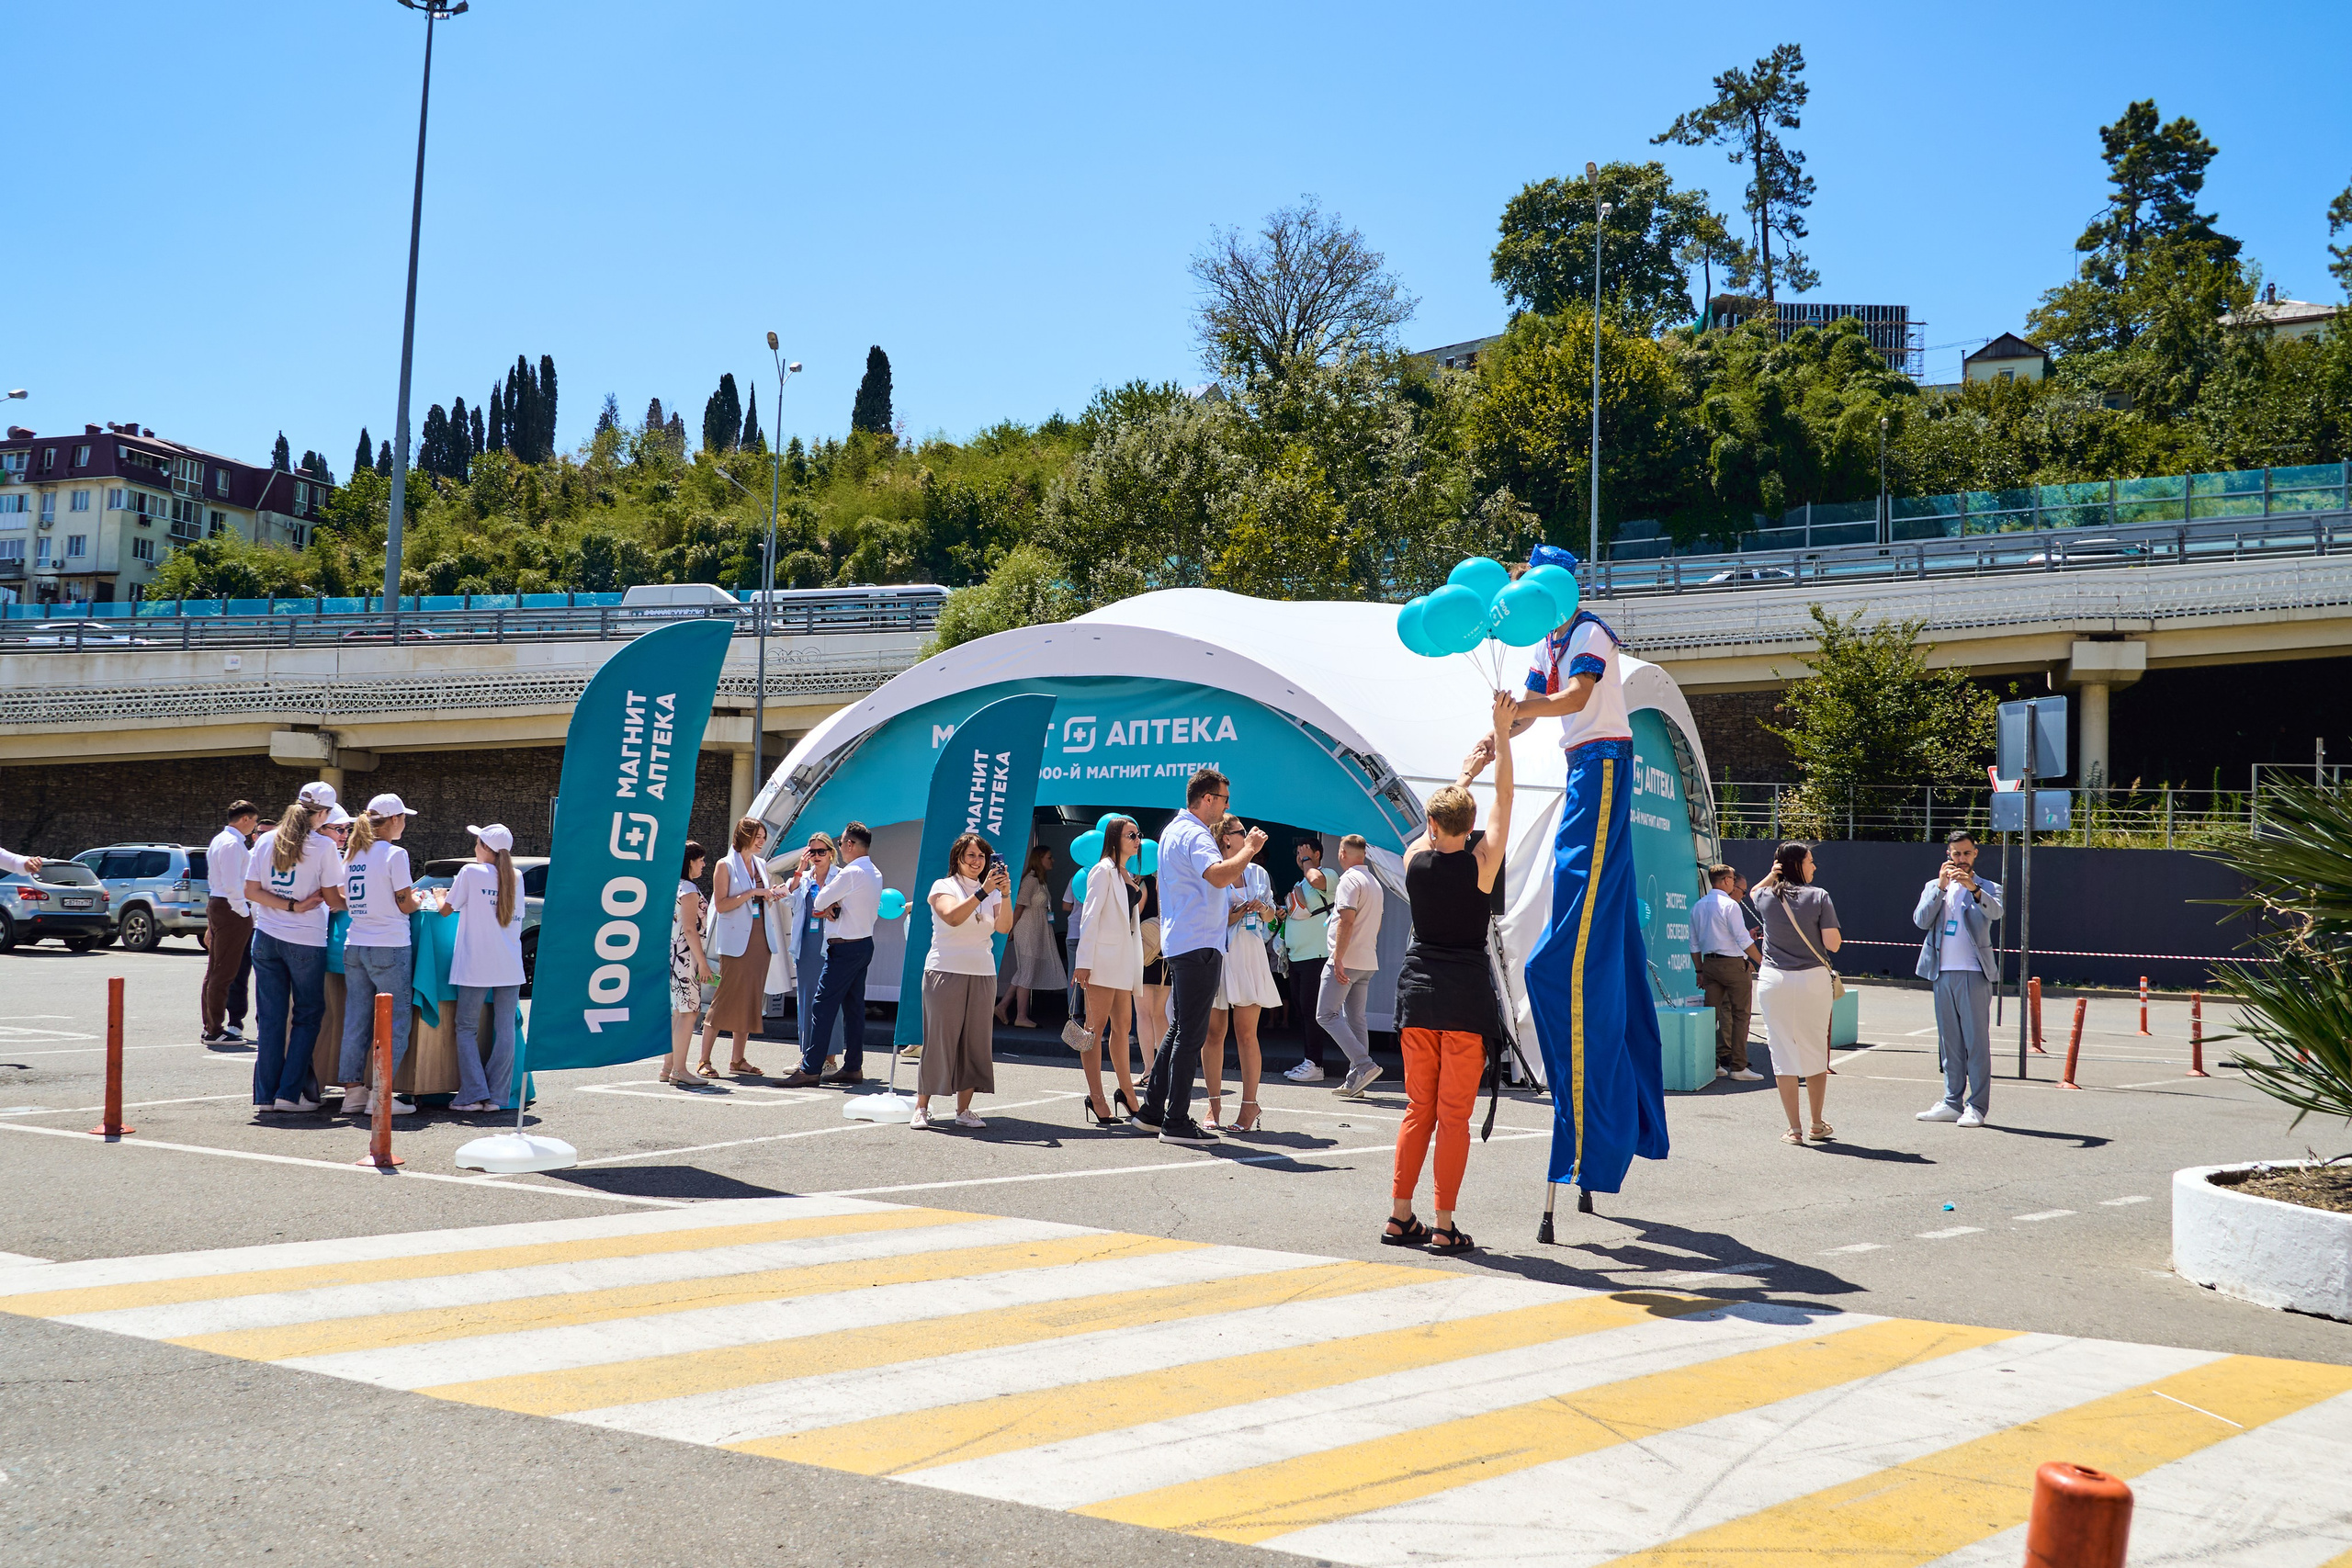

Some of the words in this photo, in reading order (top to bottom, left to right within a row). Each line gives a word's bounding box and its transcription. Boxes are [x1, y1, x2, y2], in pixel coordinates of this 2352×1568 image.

[616, 691, 647, 798] МАГНИТ
[646, 693, 676, 800] АПТЕКА
[1105, 716, 1238, 746] АПТЕКА
[966, 750, 989, 834] МАГНИТ
[987, 751, 1011, 836] АПТЕКА
[1086, 764, 1151, 779] МАГНИТ
[1645, 765, 1676, 801] АПТЕКА
[1666, 892, 1687, 909] ЭКСПРЕСС
[583, 876, 648, 1033] 1000
[1666, 923, 1690, 942] ОБСЛЕДОВ
